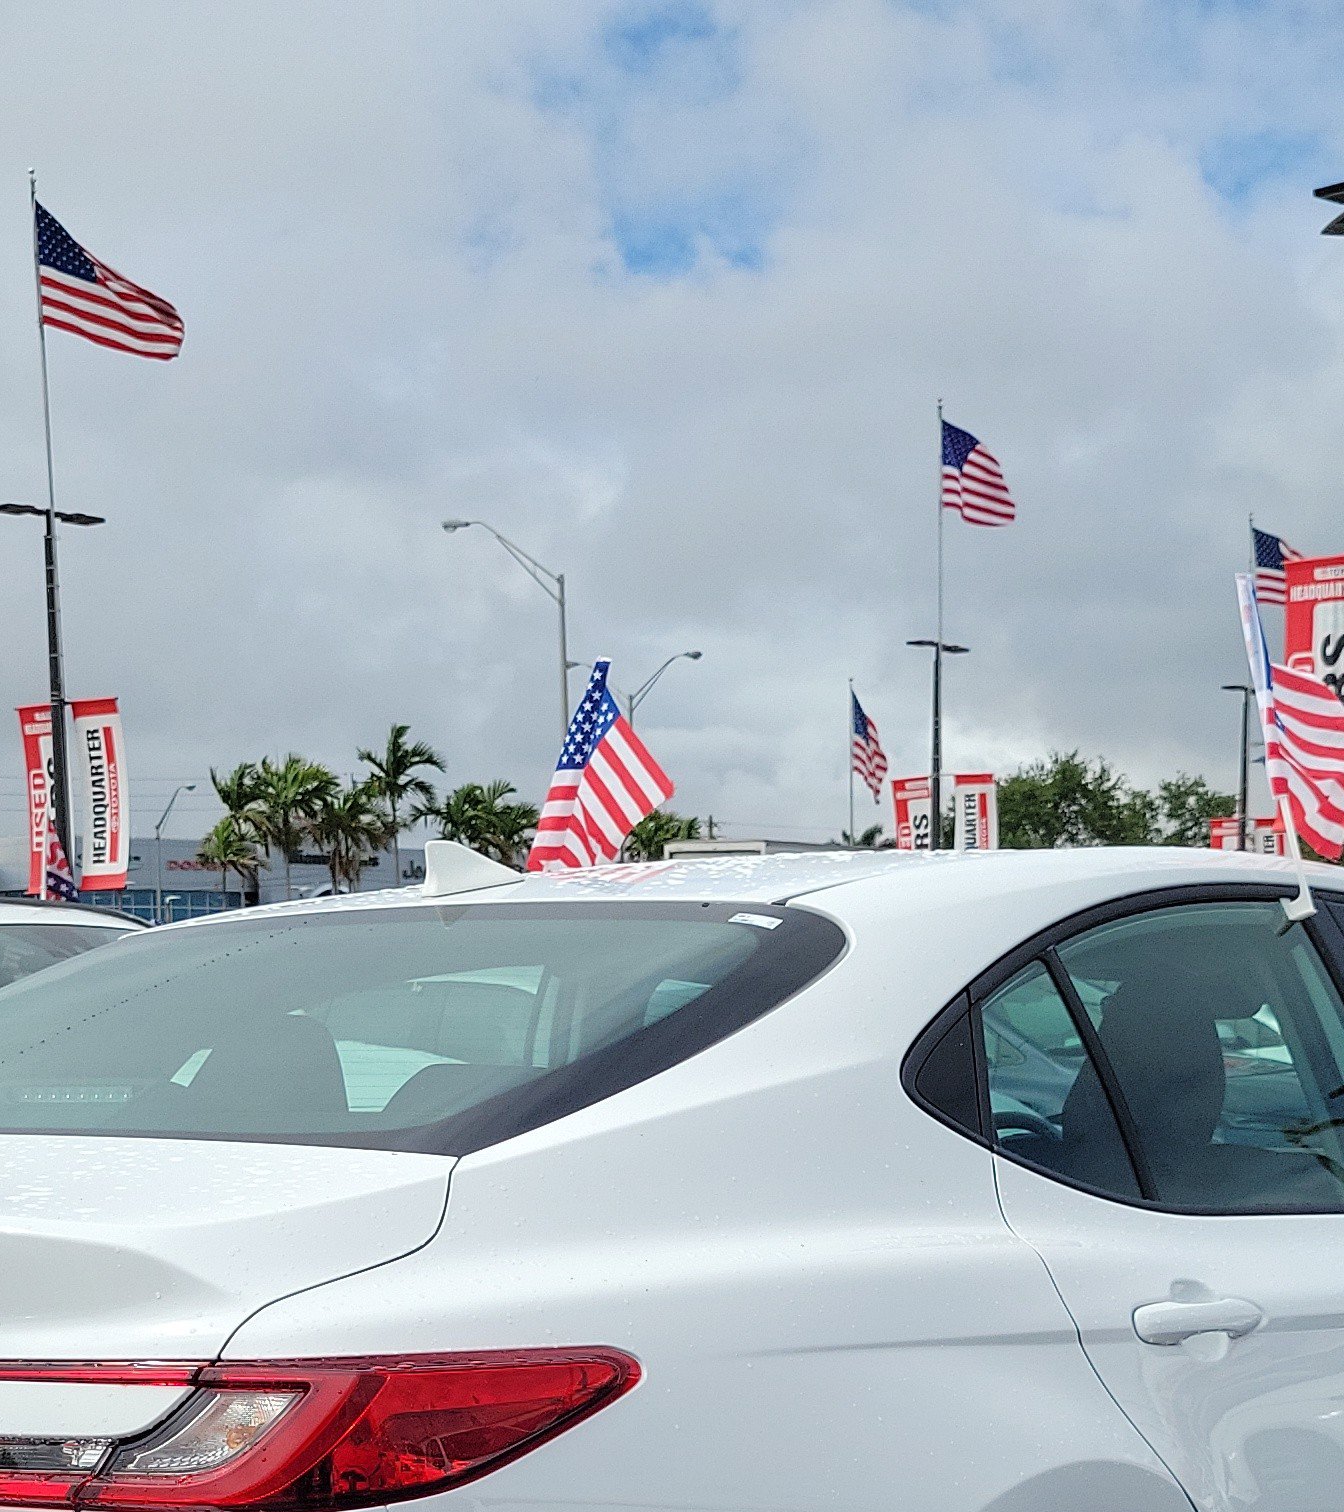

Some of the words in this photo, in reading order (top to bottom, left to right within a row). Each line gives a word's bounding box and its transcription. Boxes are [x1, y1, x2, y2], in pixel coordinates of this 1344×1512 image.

[86, 729, 110, 864] HEADQUARTER
[109, 763, 118, 816] TOYOTA
[913, 813, 929, 850] RS
